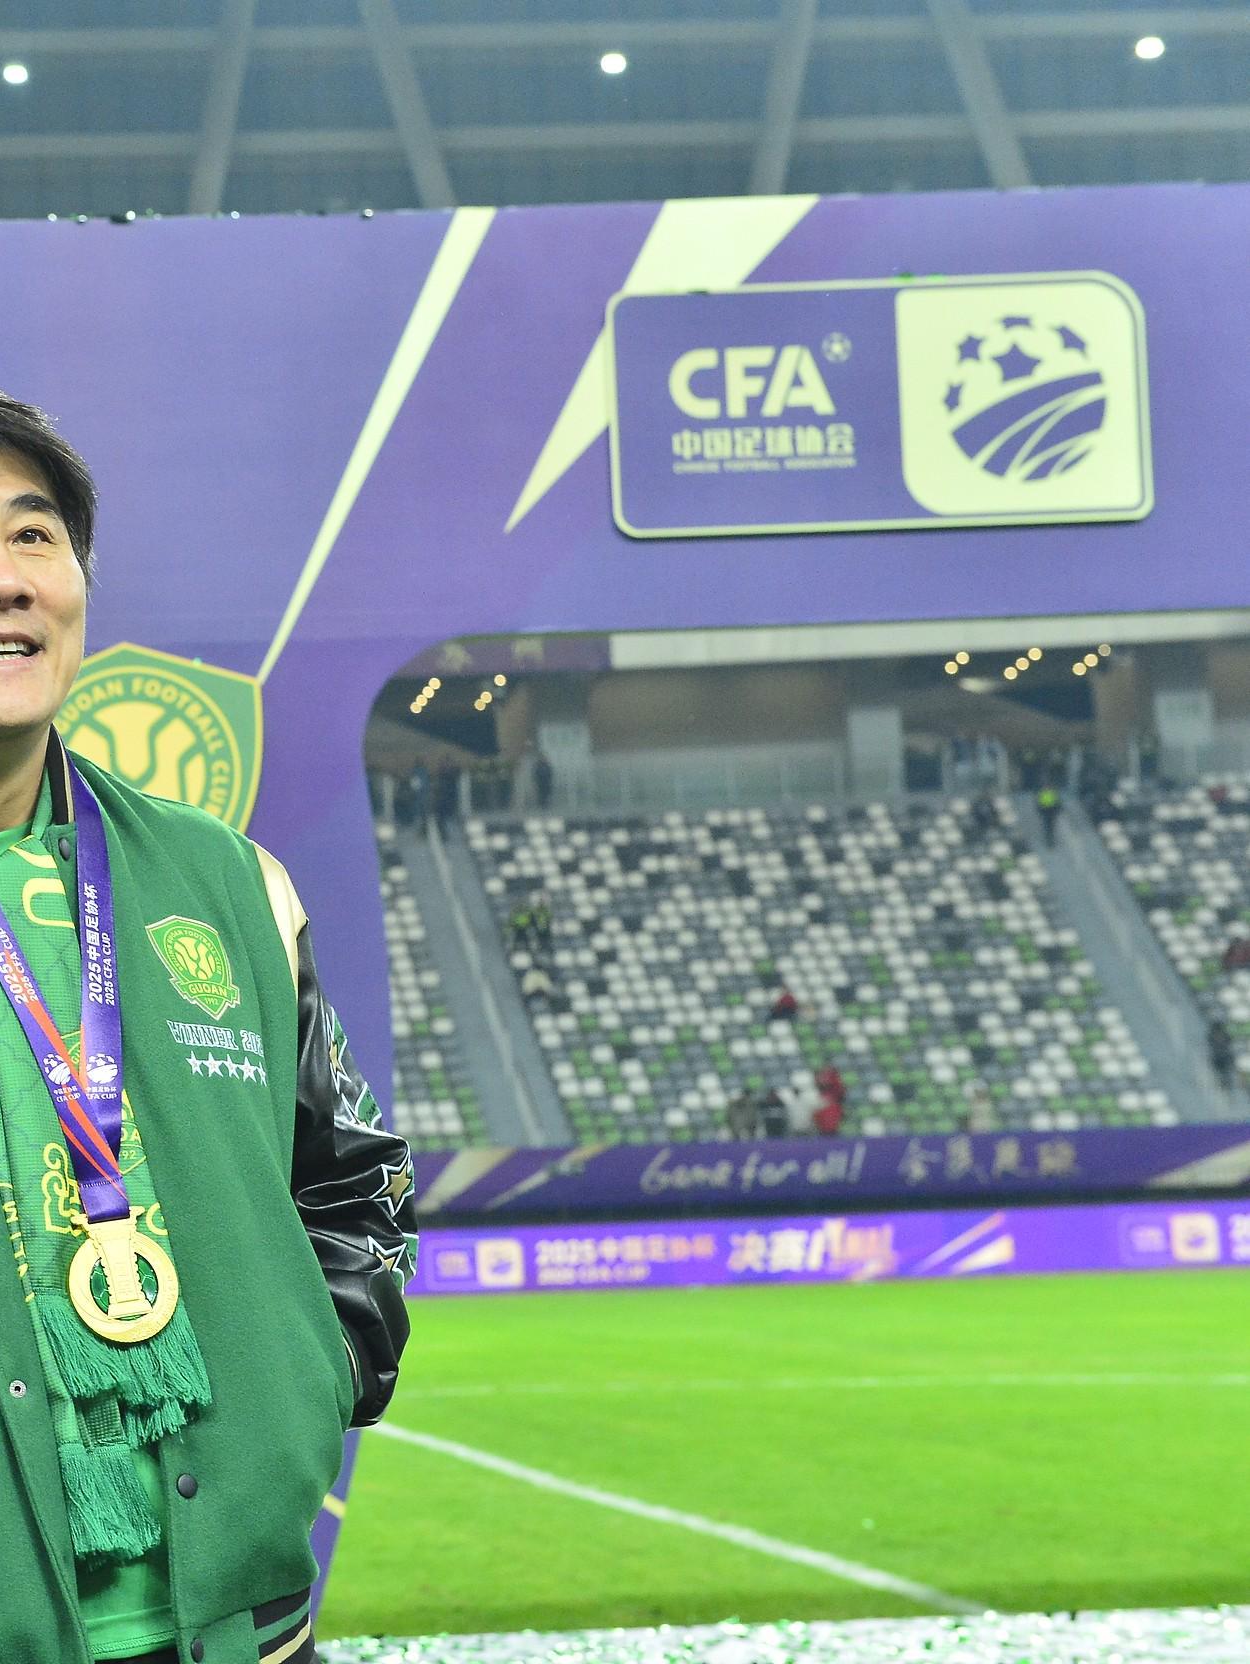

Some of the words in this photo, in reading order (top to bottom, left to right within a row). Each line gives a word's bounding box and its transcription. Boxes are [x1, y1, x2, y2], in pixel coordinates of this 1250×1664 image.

[668, 344, 837, 419] CFA
[131, 676, 225, 755] FOOTBALL
[101, 932, 113, 956] CUP
[9, 951, 25, 975] CFA
[103, 957, 114, 980] CFA
[188, 983, 228, 998] GUOAN
[166, 1020, 240, 1051] WINNER
